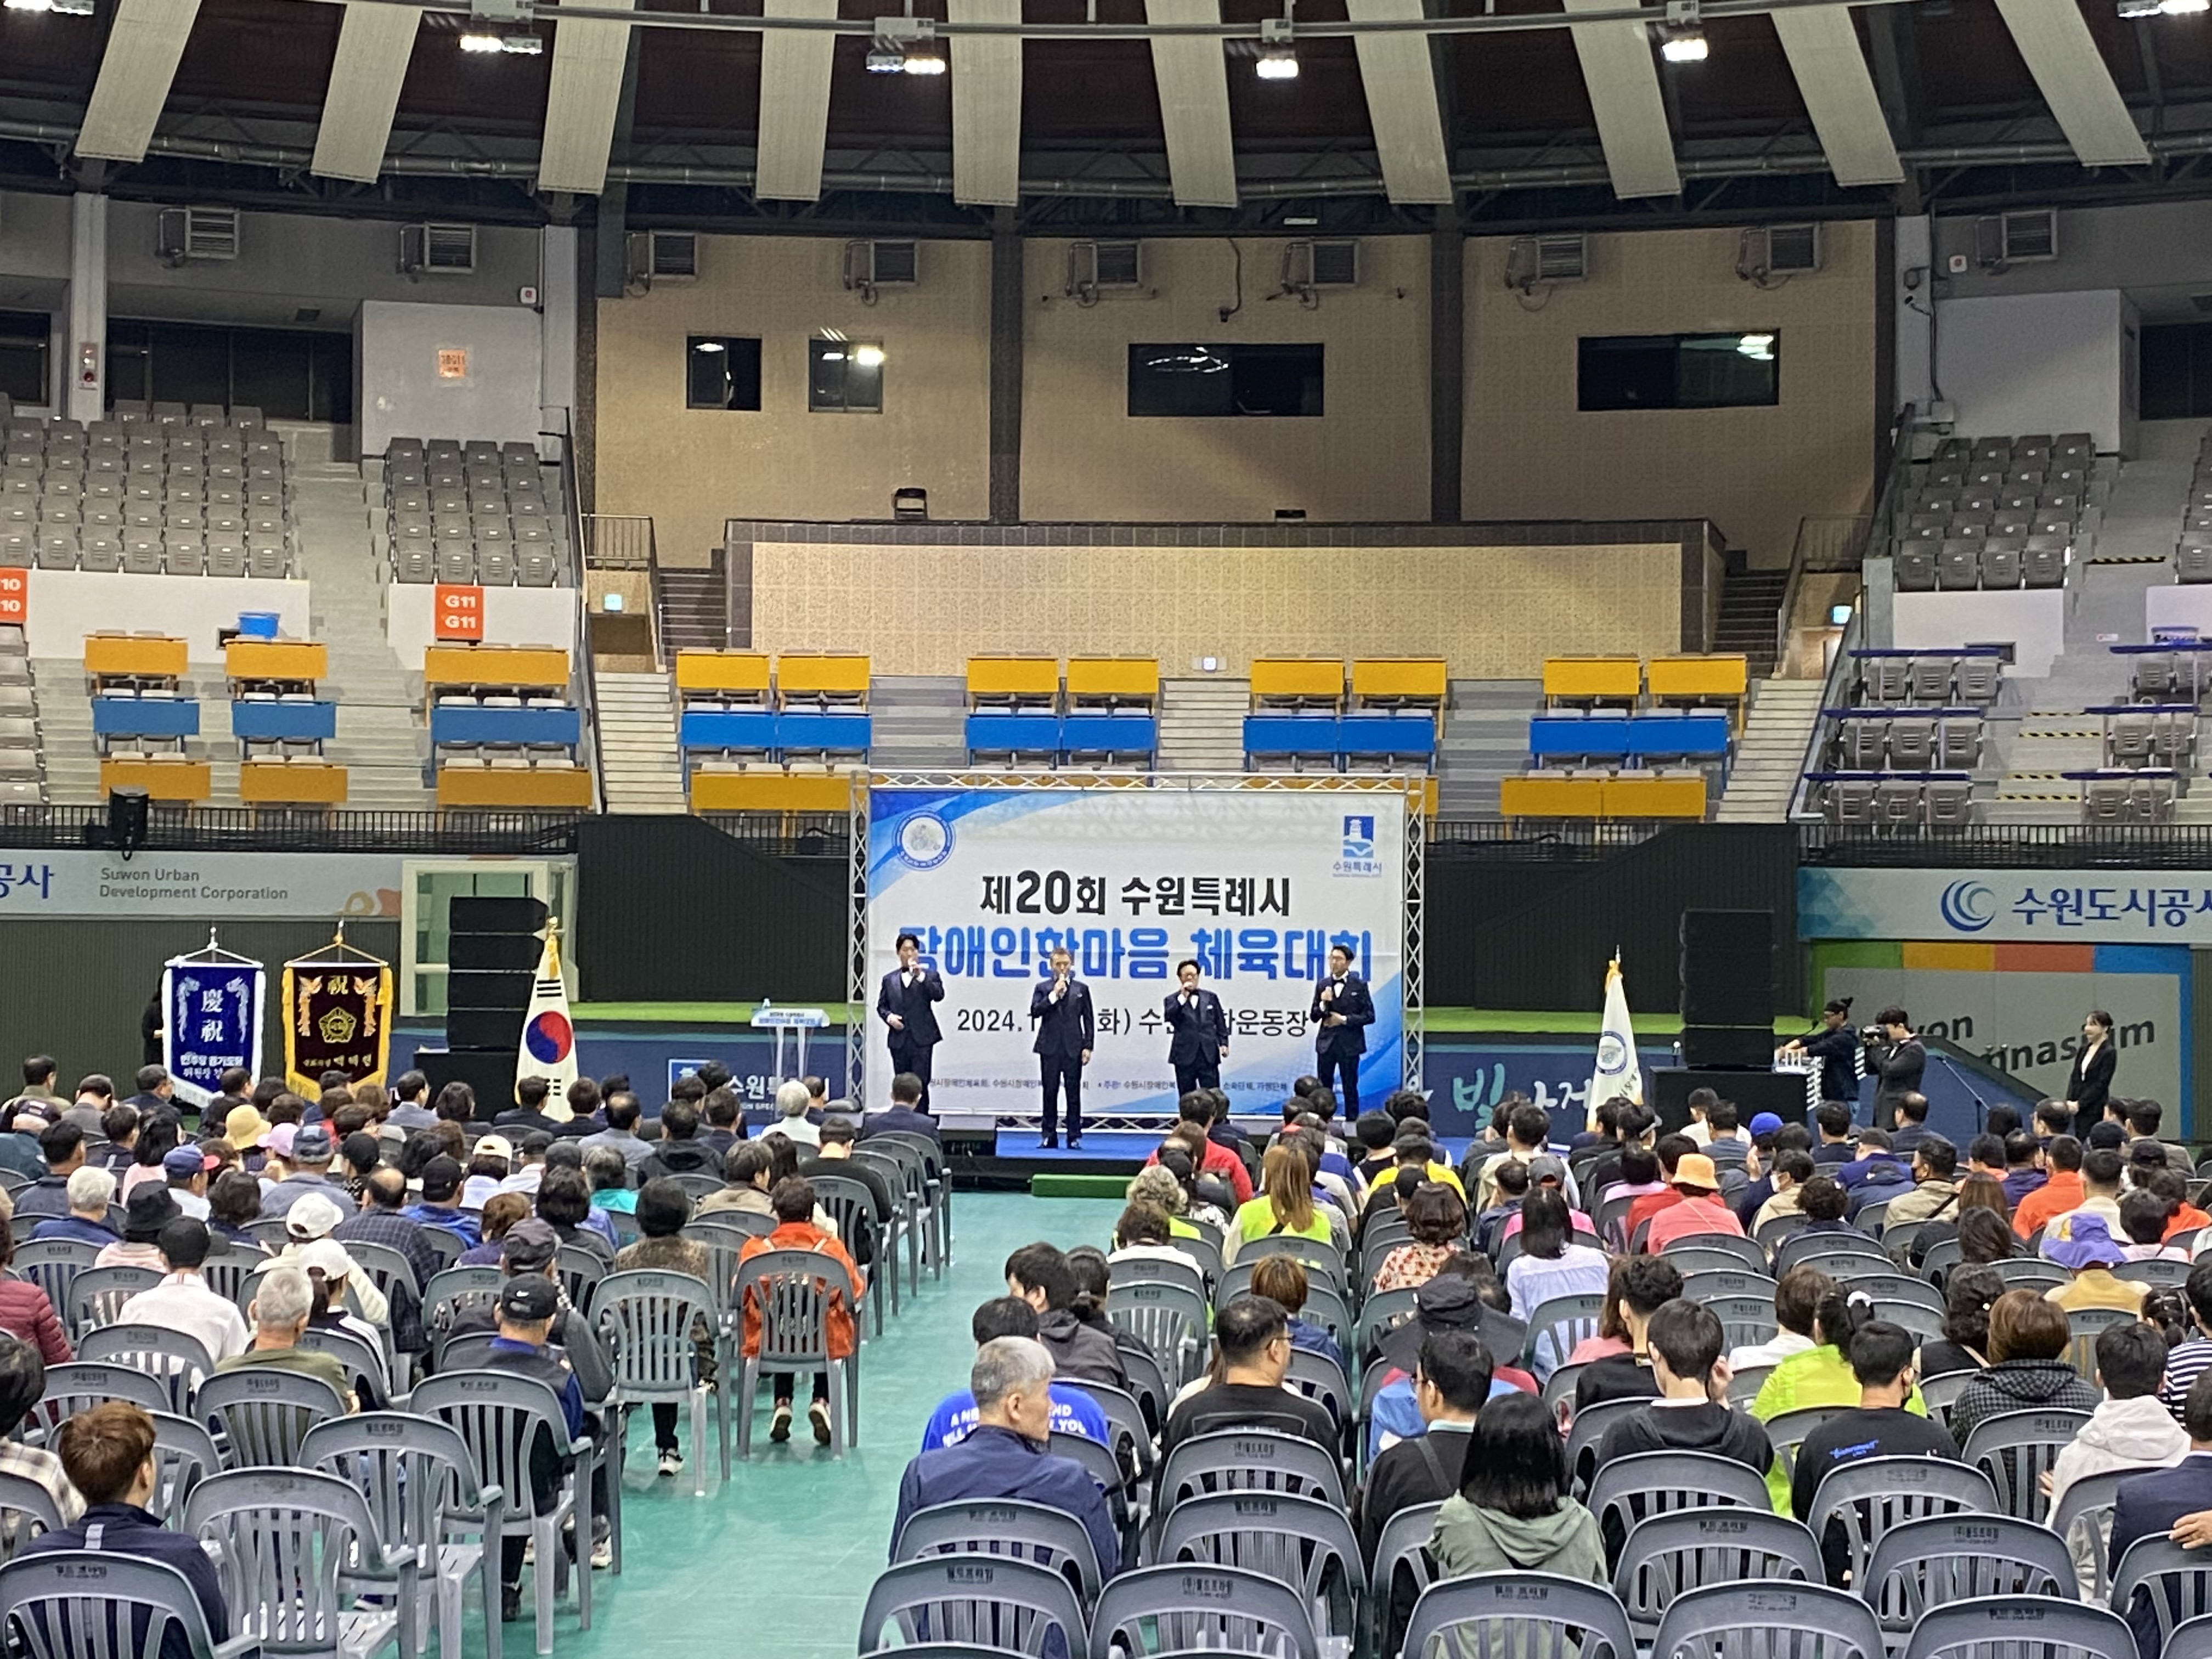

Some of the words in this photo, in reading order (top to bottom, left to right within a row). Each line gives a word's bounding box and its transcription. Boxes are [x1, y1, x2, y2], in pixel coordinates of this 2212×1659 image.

[445, 595, 476, 608] G11
[445, 615, 476, 629] G11
[100, 867, 150, 881] Suwon
[154, 868, 200, 882] Urban
[1332, 861, 1382, 873] 수원특례시
[99, 885, 197, 900] Development
[200, 886, 288, 901] Corporation
[979, 870, 1106, 916] 제20회
[1121, 876, 1291, 917] 수원특례시
[898, 925, 1169, 979] 장애인한마음
[1190, 927, 1372, 982] 체육대회
